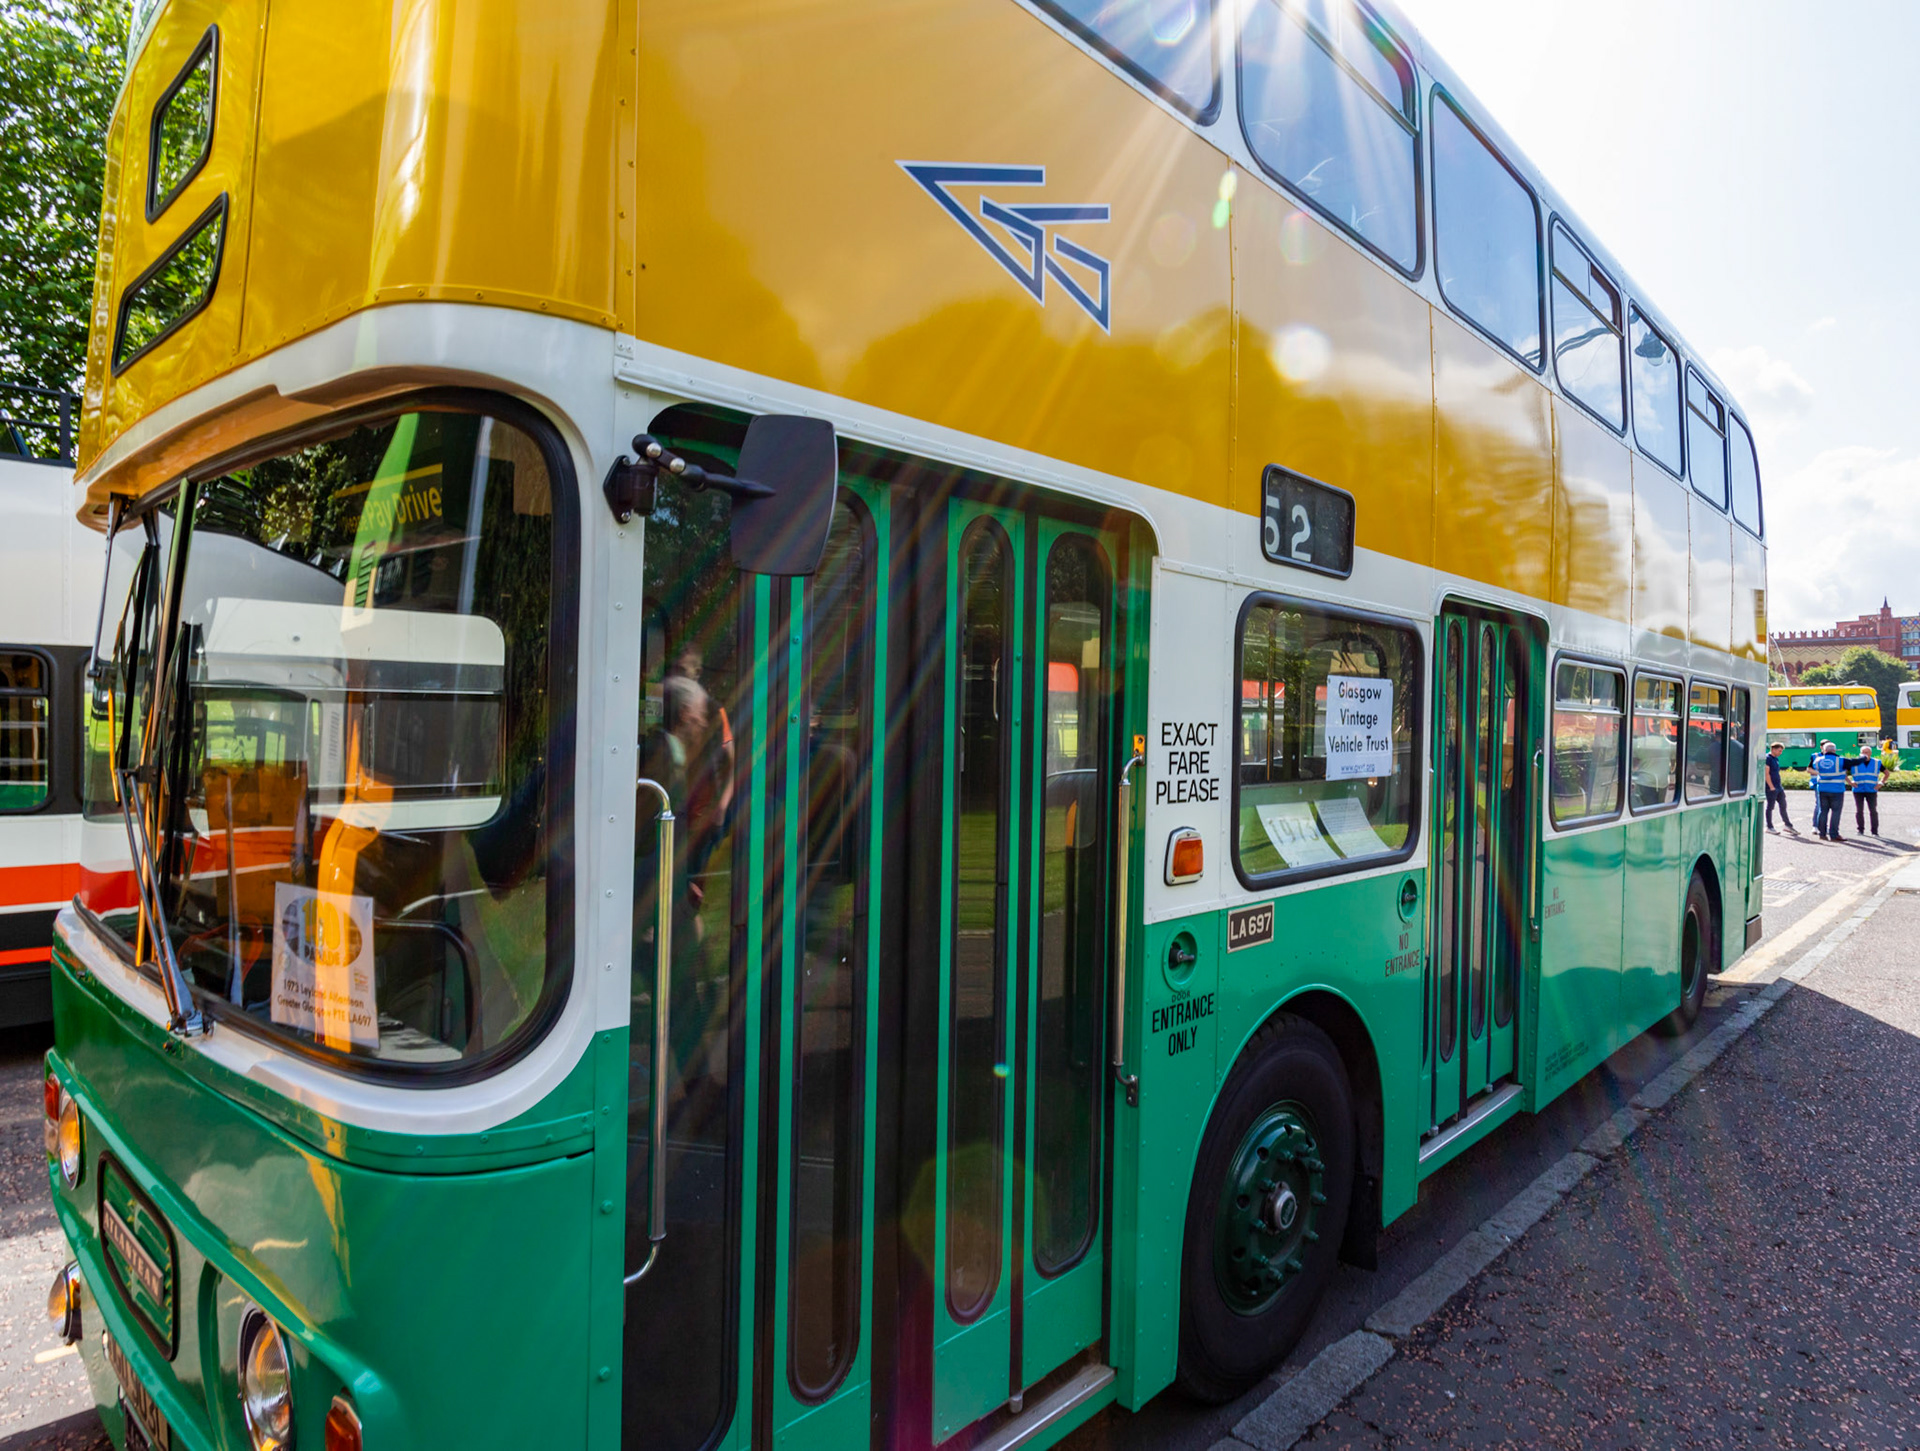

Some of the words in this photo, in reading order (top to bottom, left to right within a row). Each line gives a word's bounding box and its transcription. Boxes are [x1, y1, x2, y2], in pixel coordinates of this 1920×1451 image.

[364, 500, 393, 533] Pay
[392, 485, 442, 524] Drive
[1339, 681, 1382, 703] Glasgow
[1340, 708, 1378, 729] Vintage
[1161, 722, 1218, 746] EXACT
[1328, 735, 1363, 753] Vehicle
[1366, 735, 1389, 751] Trust
[1168, 751, 1210, 776] FARE
[1156, 777, 1220, 806] PLEASE
[1231, 912, 1272, 940] LA697
[1399, 932, 1409, 951] NO
[1385, 949, 1420, 978] ENTRANCE
[1171, 990, 1191, 1003] DOOR
[1152, 993, 1215, 1034] ENTRANCE
[1168, 1025, 1198, 1057] ONLY
[104, 1211, 160, 1297] ATLANTEAN
